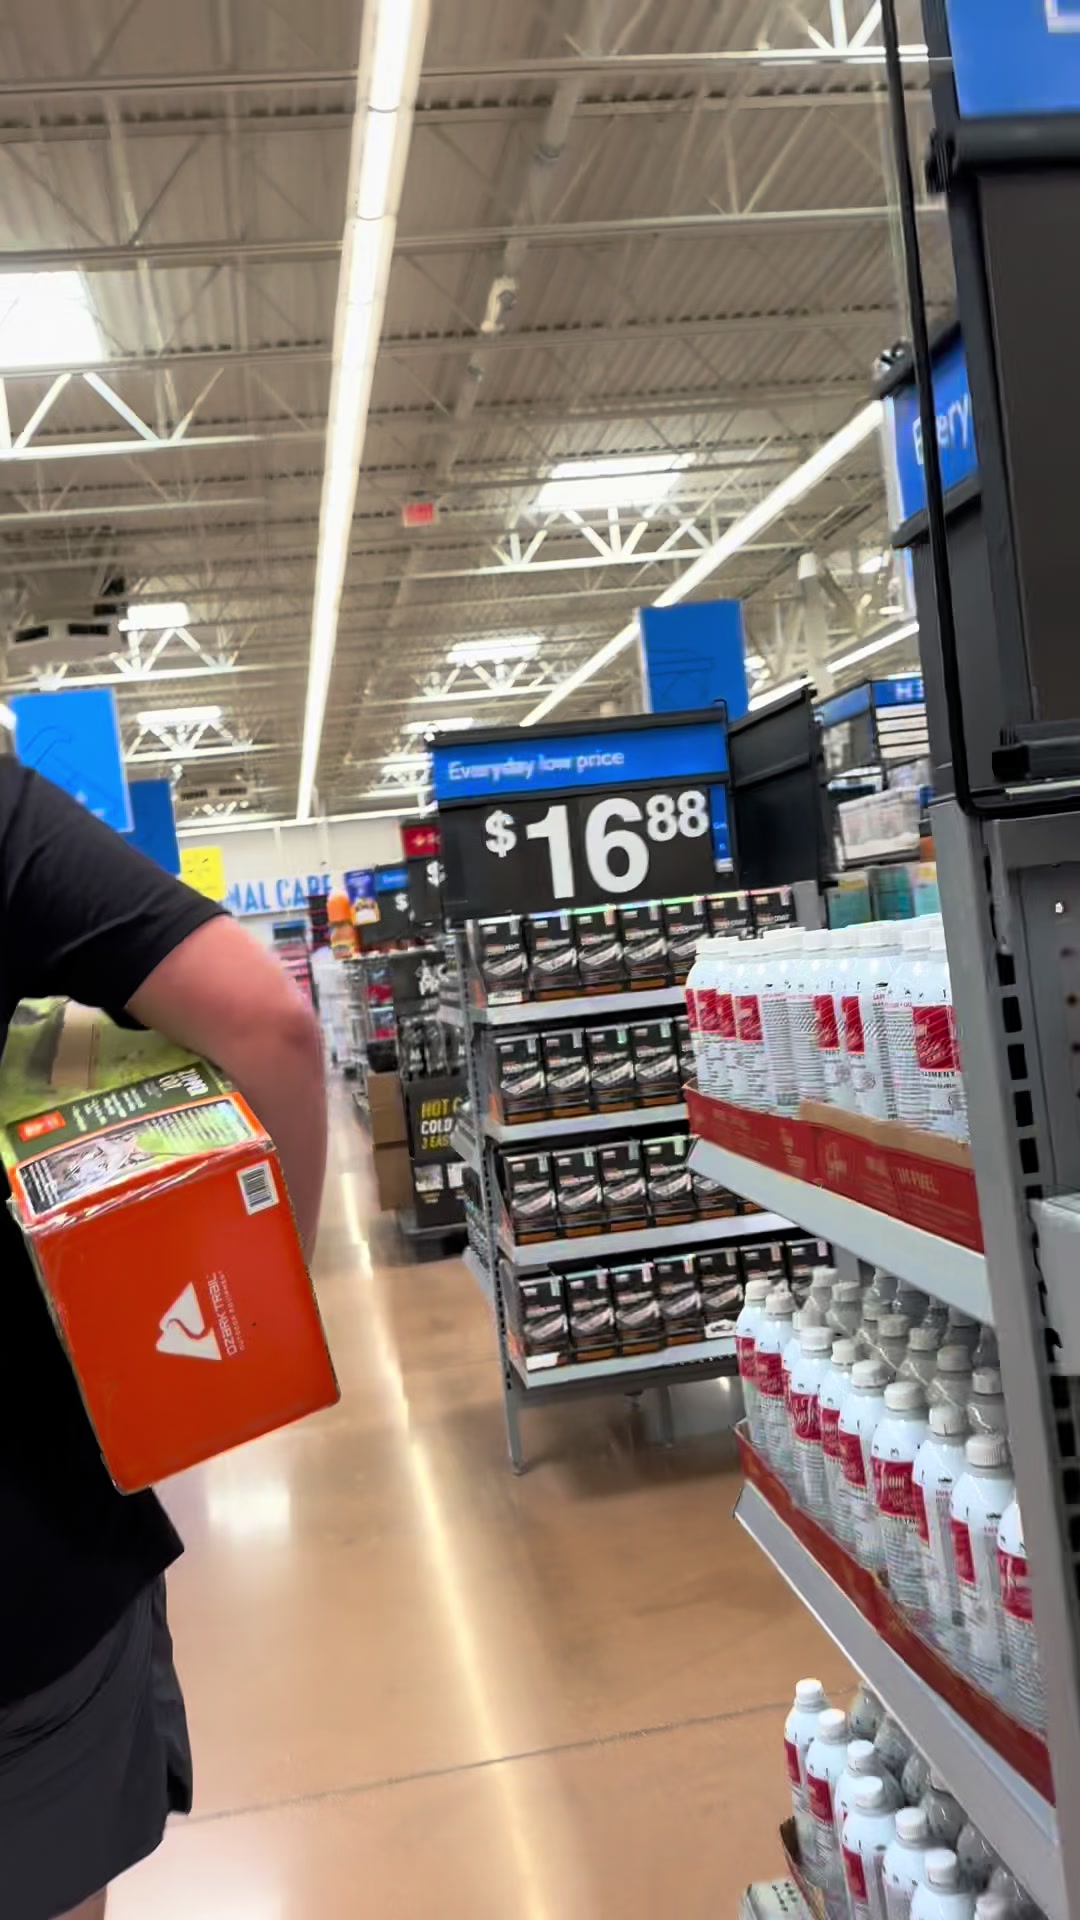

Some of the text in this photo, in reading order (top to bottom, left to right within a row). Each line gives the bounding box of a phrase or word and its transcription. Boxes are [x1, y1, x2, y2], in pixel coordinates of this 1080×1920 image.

[448, 749, 625, 783] Everyday low price
[421, 1098, 449, 1119] HOT
[421, 1117, 453, 1136] COLD
[430, 1133, 449, 1148] EAS
